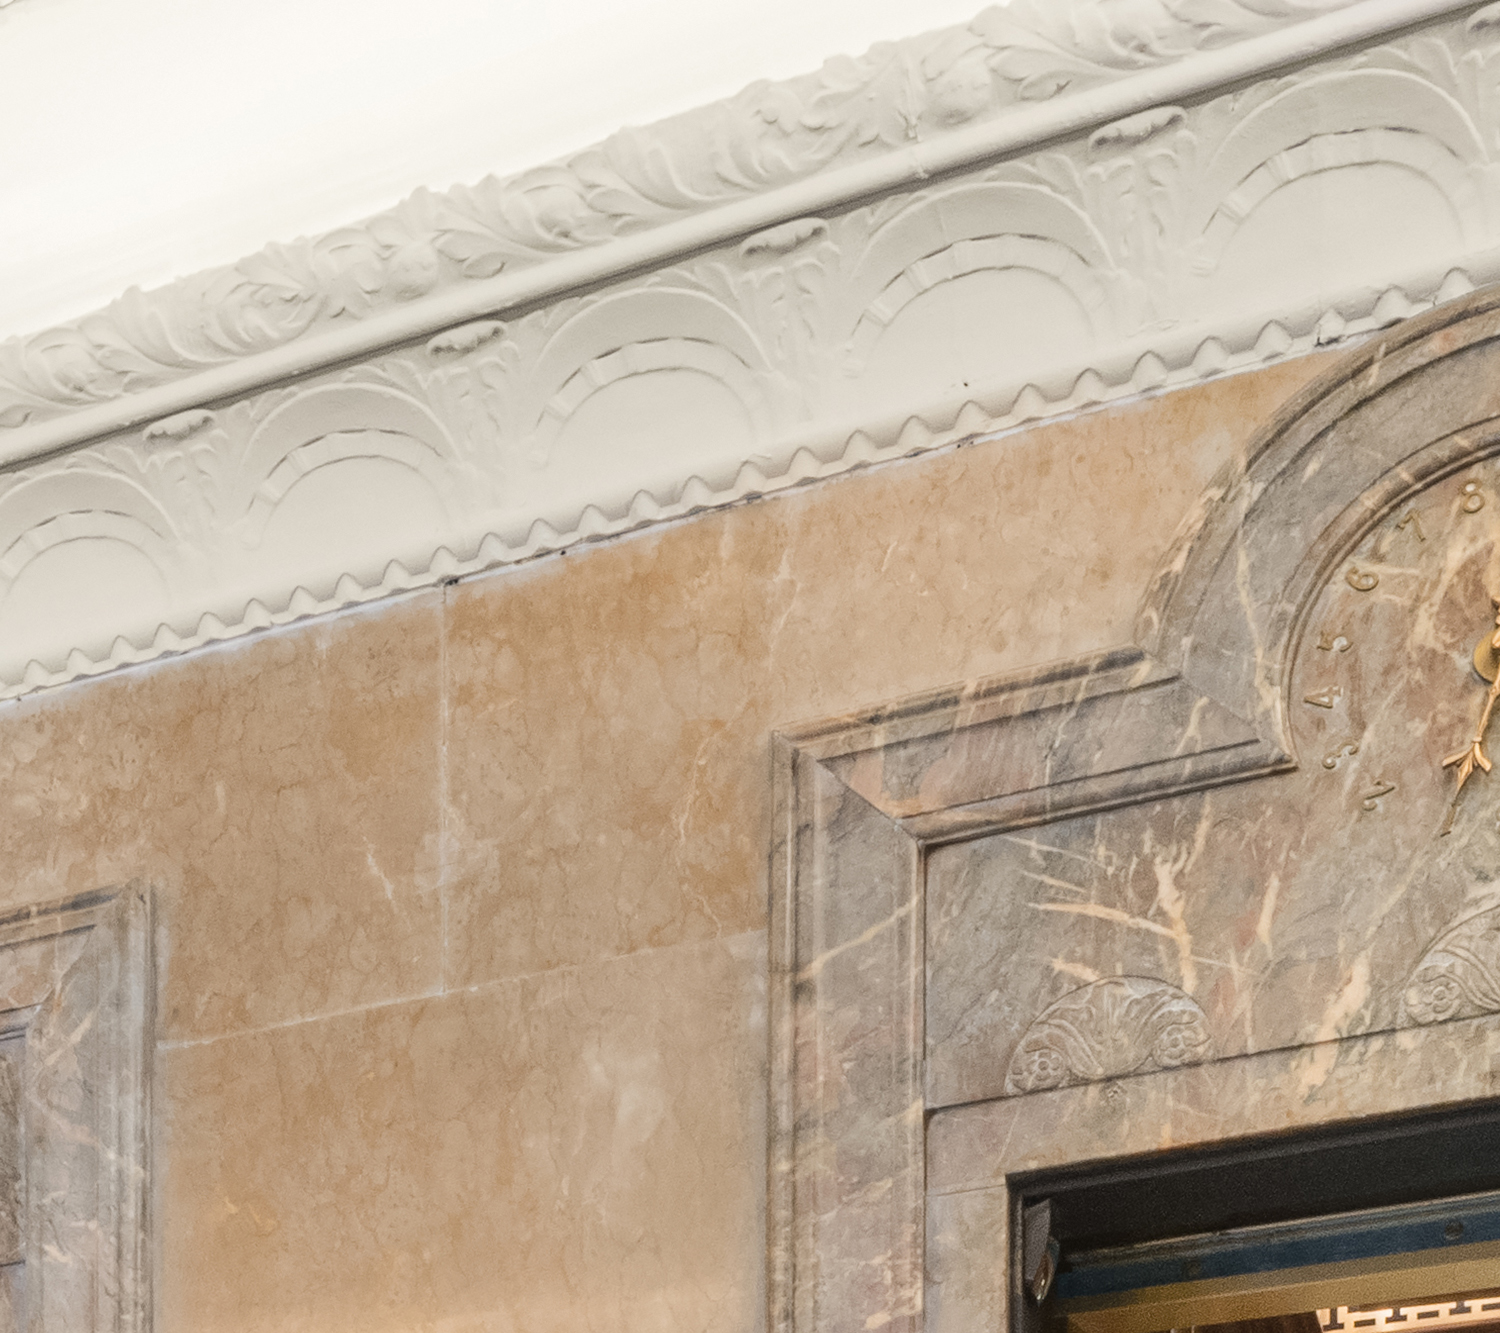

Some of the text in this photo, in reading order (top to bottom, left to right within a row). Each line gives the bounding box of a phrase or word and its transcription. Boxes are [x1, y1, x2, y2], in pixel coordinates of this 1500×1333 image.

[1460, 476, 1486, 514] 8
[1396, 507, 1426, 543] 7
[1345, 566, 1380, 592] 6
[1316, 629, 1354, 653] 5
[1303, 684, 1343, 709] 4
[1321, 741, 1360, 770] 3
